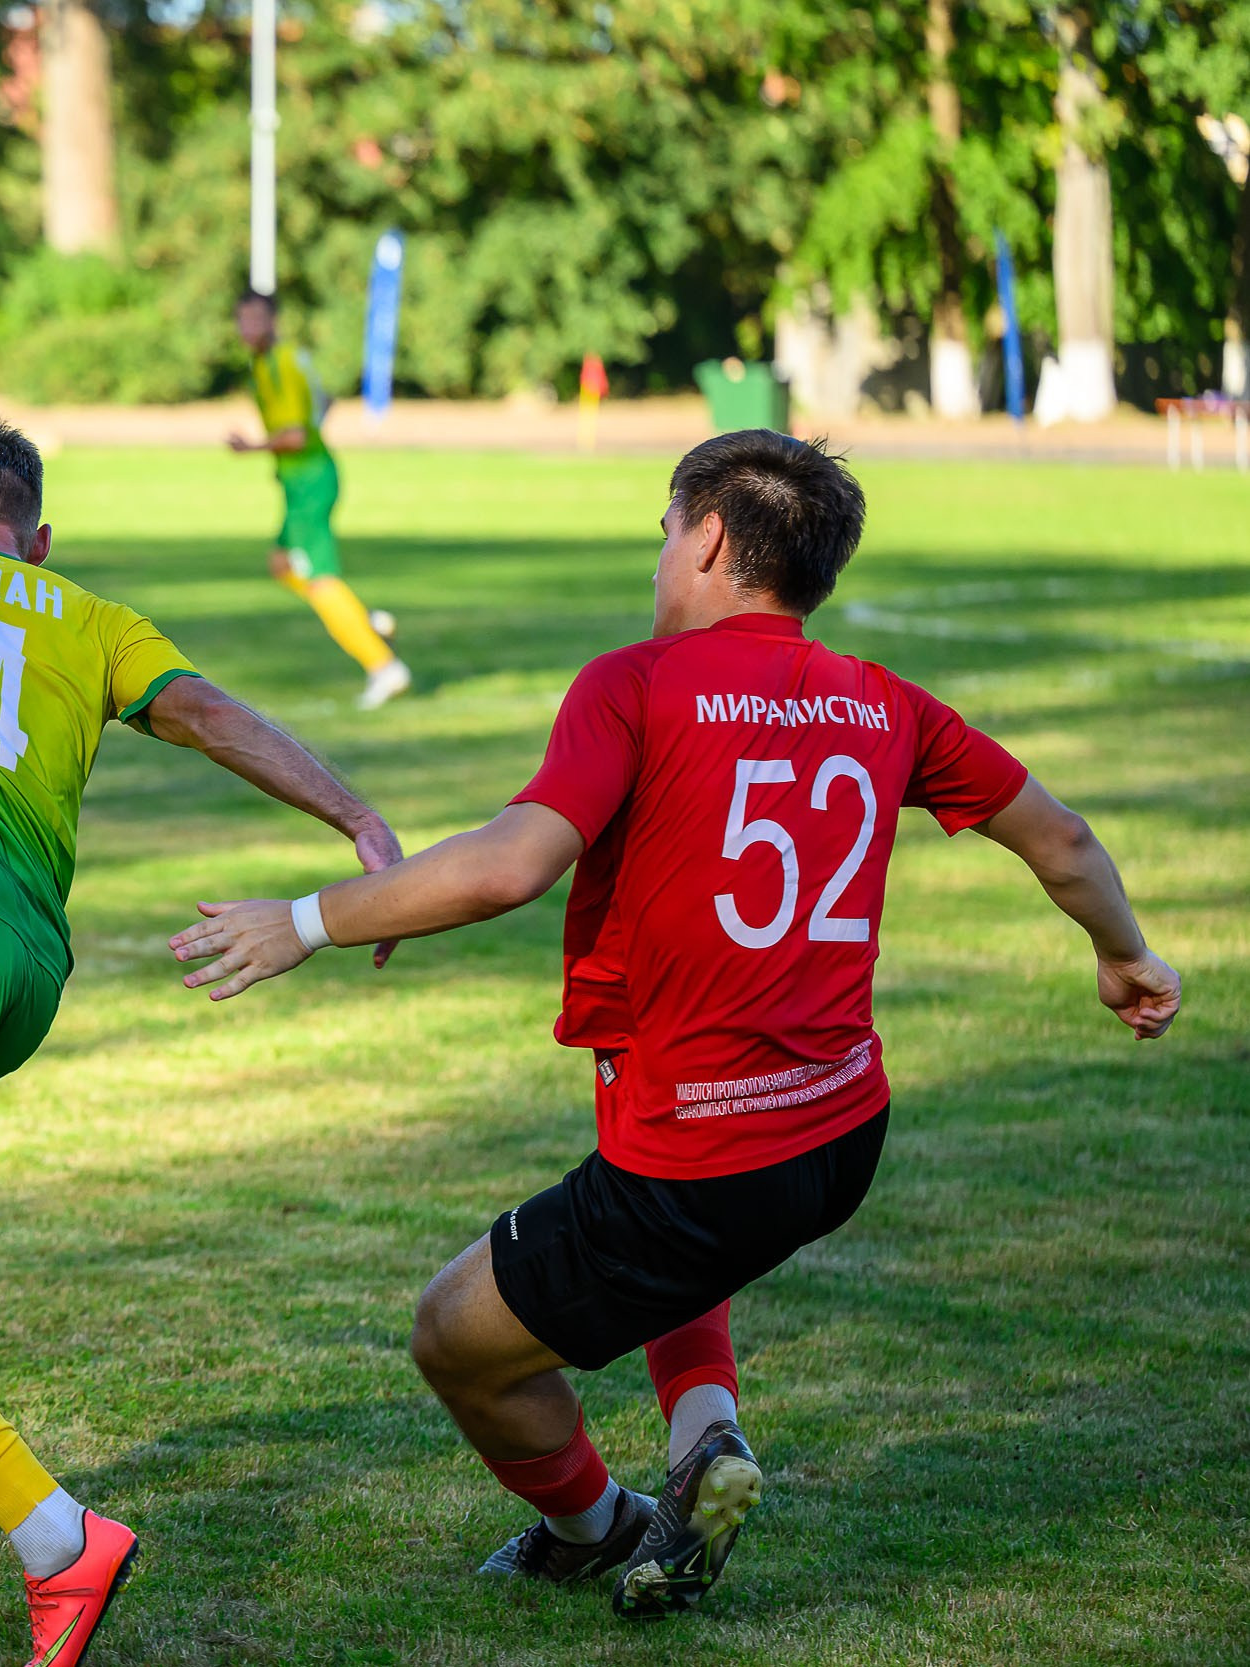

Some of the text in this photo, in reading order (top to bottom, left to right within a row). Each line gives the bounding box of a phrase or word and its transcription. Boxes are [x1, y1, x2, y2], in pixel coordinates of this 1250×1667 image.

[695, 694, 890, 731] МИРАМИСТИН
[714, 755, 877, 949] 52
[675, 1082, 712, 1101] ИМЕЮТСЯ
[675, 1101, 727, 1119] ОЗНАКОМИТЬСЯ
[727, 1100, 733, 1114] С
[732, 1093, 777, 1113] ИНСТРУКЦИЕЙ
